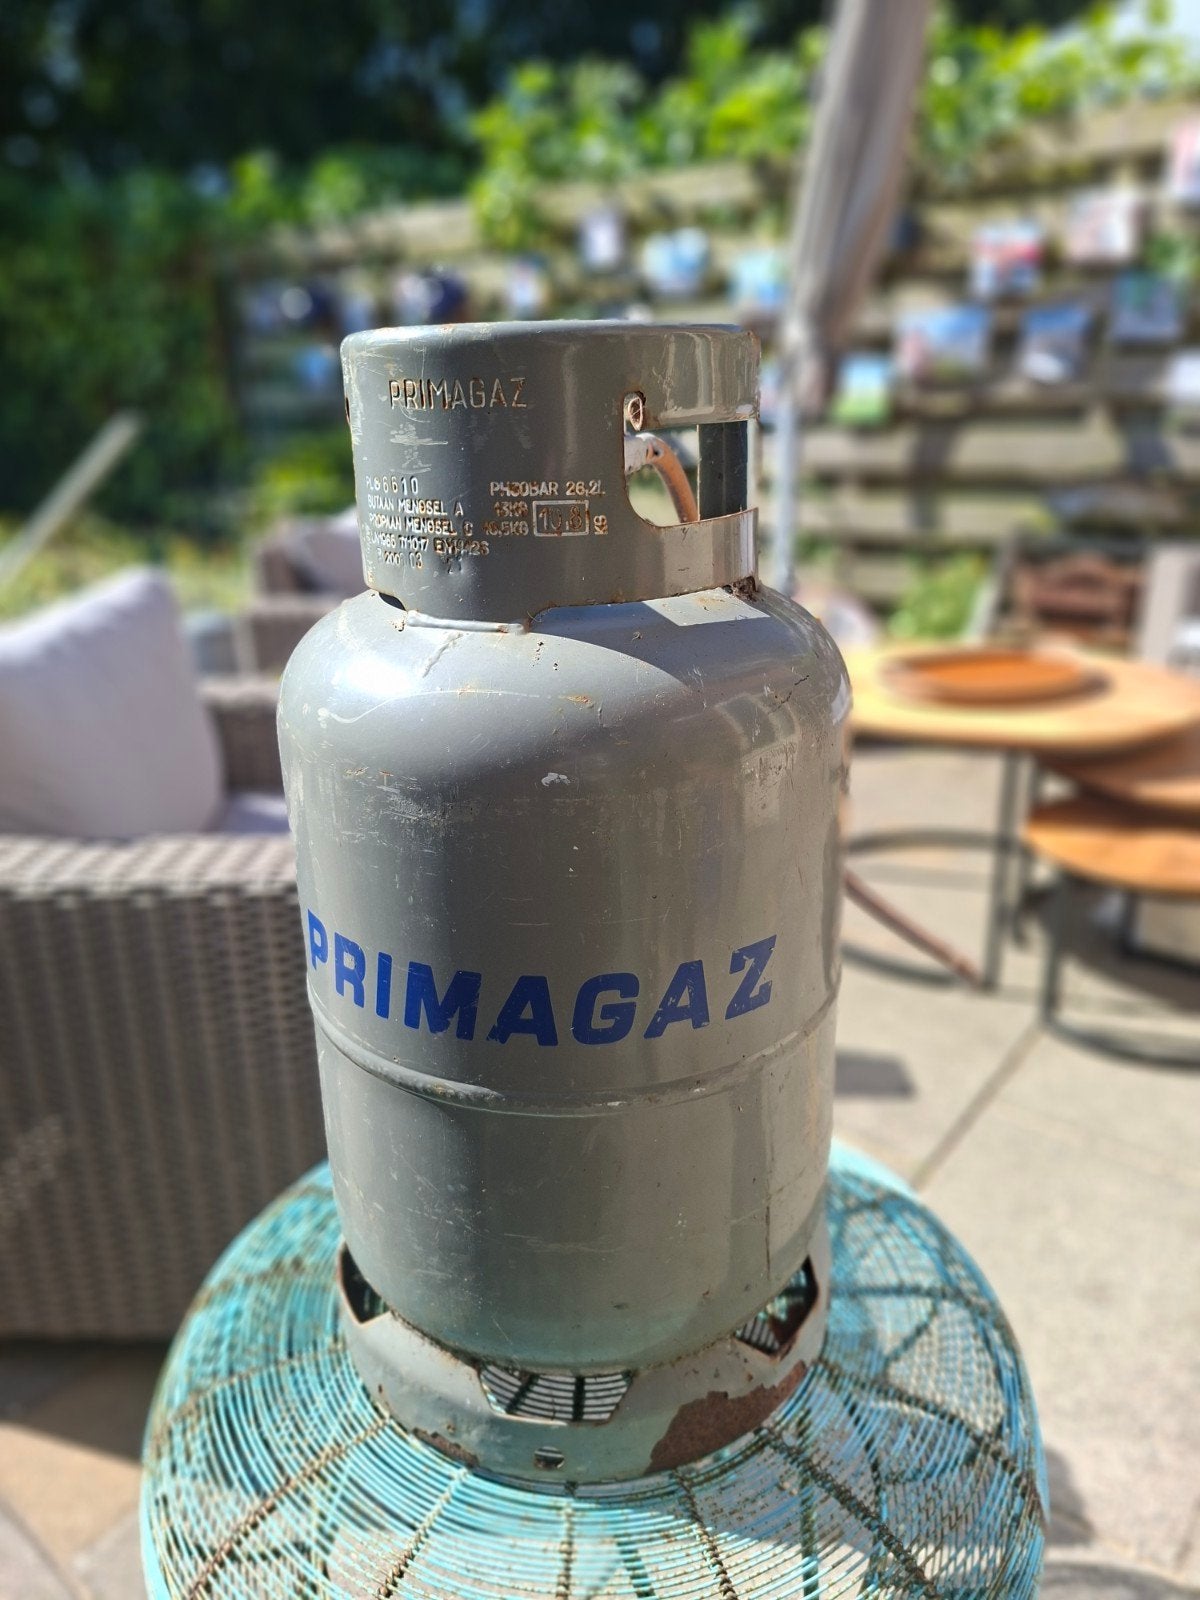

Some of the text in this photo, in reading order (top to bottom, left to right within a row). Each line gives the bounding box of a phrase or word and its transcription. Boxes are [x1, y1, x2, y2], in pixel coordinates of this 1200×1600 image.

[389, 377, 528, 410] PRIMAGAZ
[367, 494, 395, 511] BUTAAN
[454, 501, 464, 517] A
[369, 512, 402, 532] PROPAAN
[307, 908, 778, 1047] PRIMAGAZ
